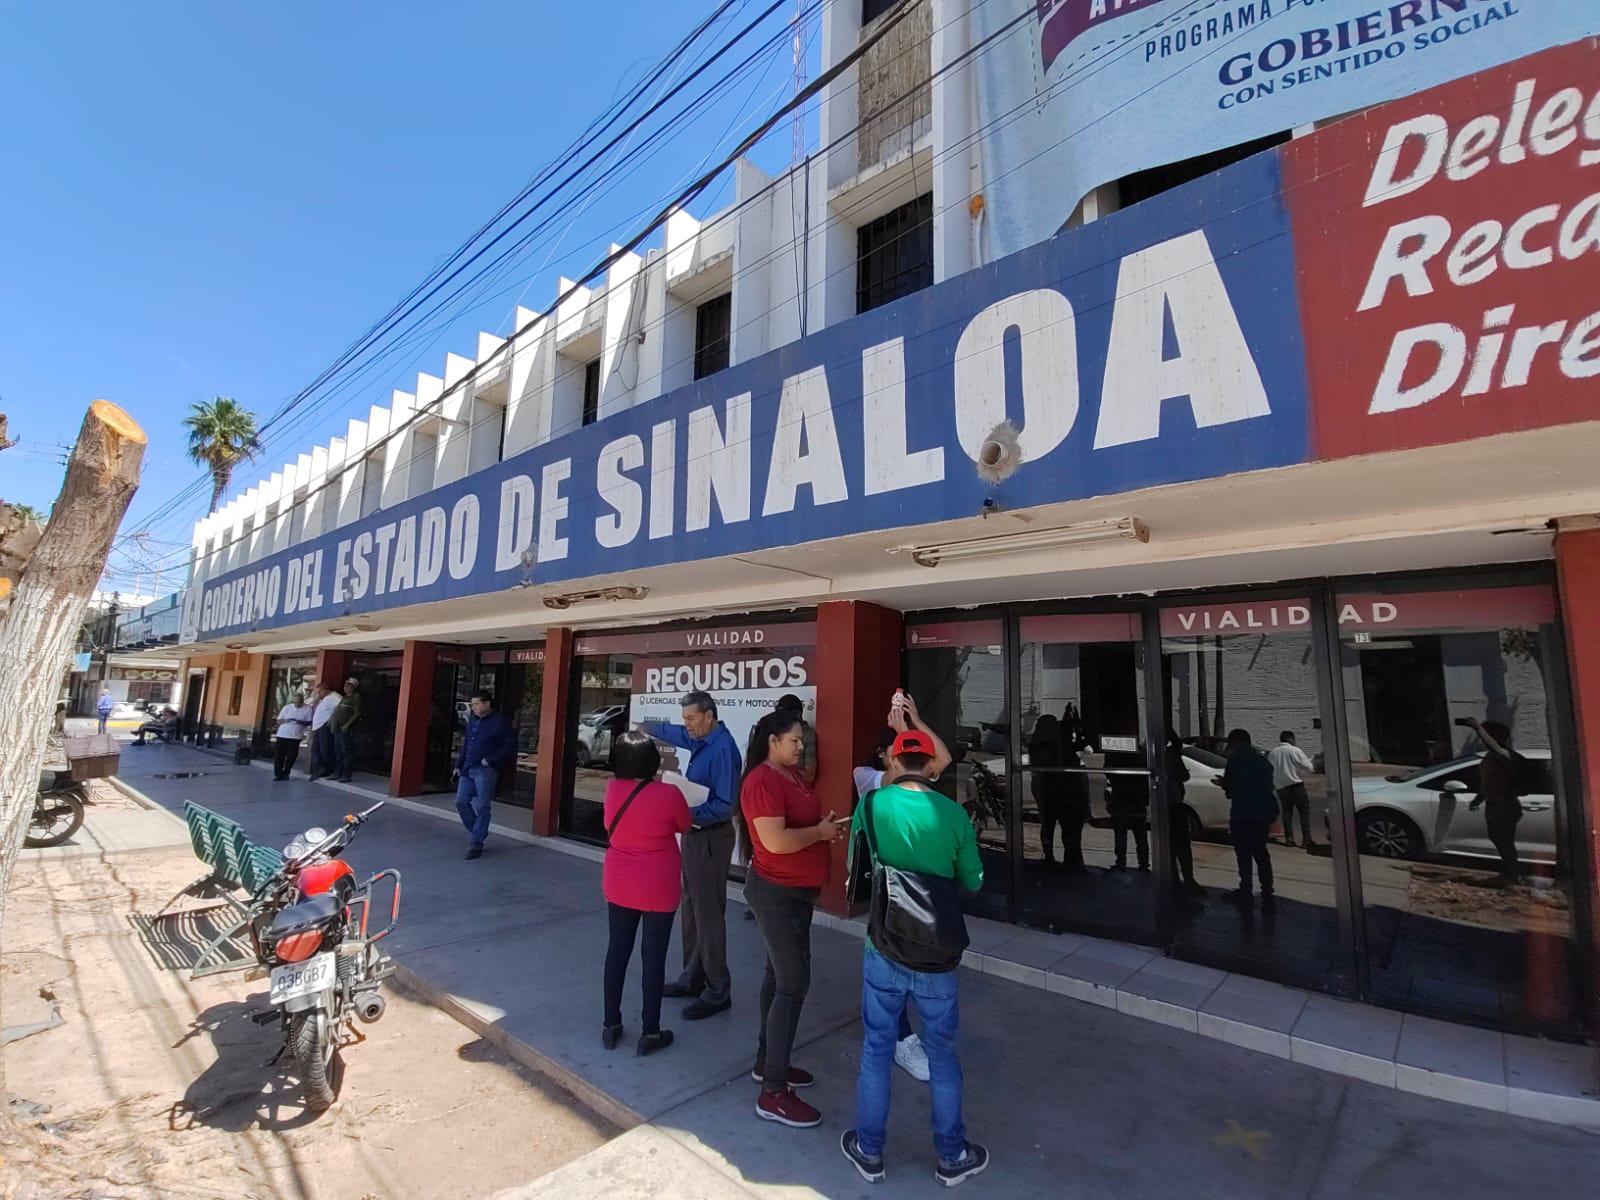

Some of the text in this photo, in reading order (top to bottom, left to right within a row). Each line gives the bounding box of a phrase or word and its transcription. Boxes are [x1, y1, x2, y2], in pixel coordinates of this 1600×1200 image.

[1145, 0, 1272, 63] PROGRAMA
[1218, 0, 1488, 86] GOBIERN
[1218, 0, 1520, 110] CON SENTIDO SOCIAL
[202, 228, 1271, 632] GOBIERNO DEL ESTADO DE SINALOA
[646, 656, 807, 694] REQUISITOS
[686, 629, 765, 647] VIALIDAD
